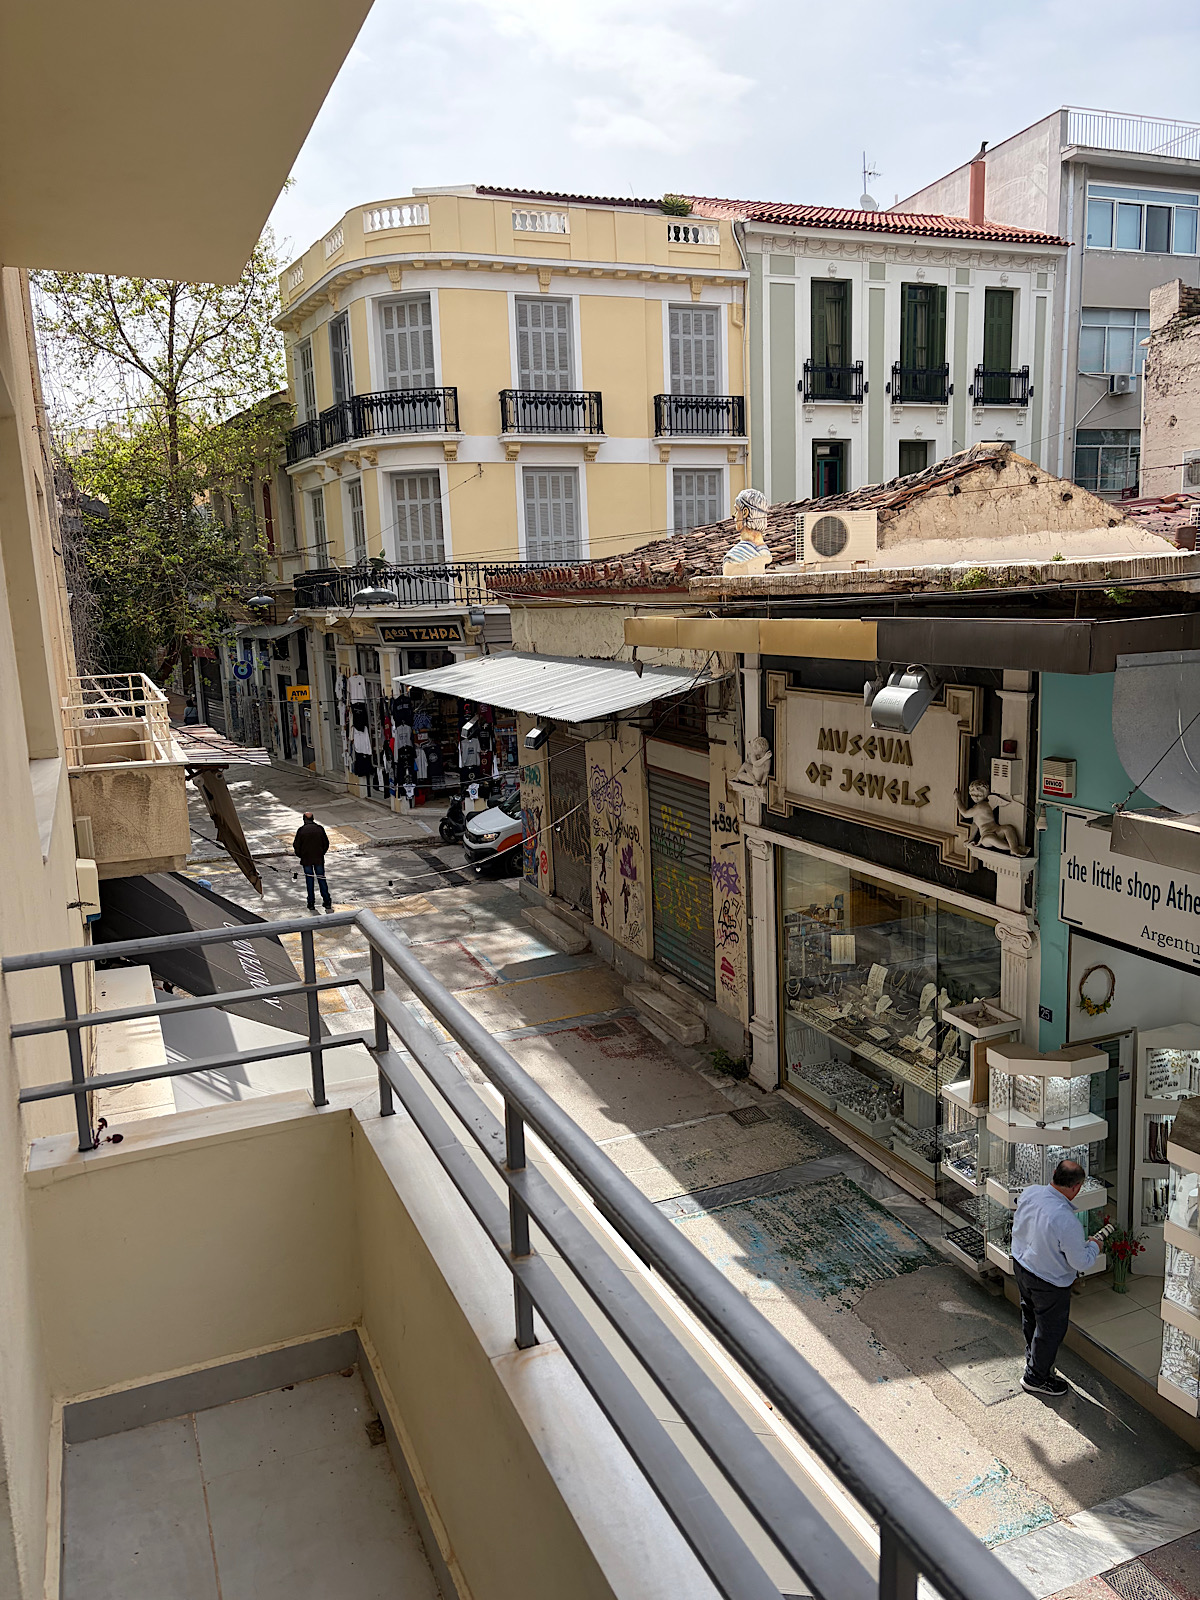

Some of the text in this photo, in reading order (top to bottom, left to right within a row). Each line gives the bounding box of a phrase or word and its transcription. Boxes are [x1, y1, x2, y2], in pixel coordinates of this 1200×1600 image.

[817, 728, 913, 766] MUSEUM
[805, 761, 931, 808] OF JEWELS
[1067, 855, 1200, 916] the little shop Athe
[1140, 925, 1200, 956] Argentu
[1040, 1007, 1050, 1019] 25
